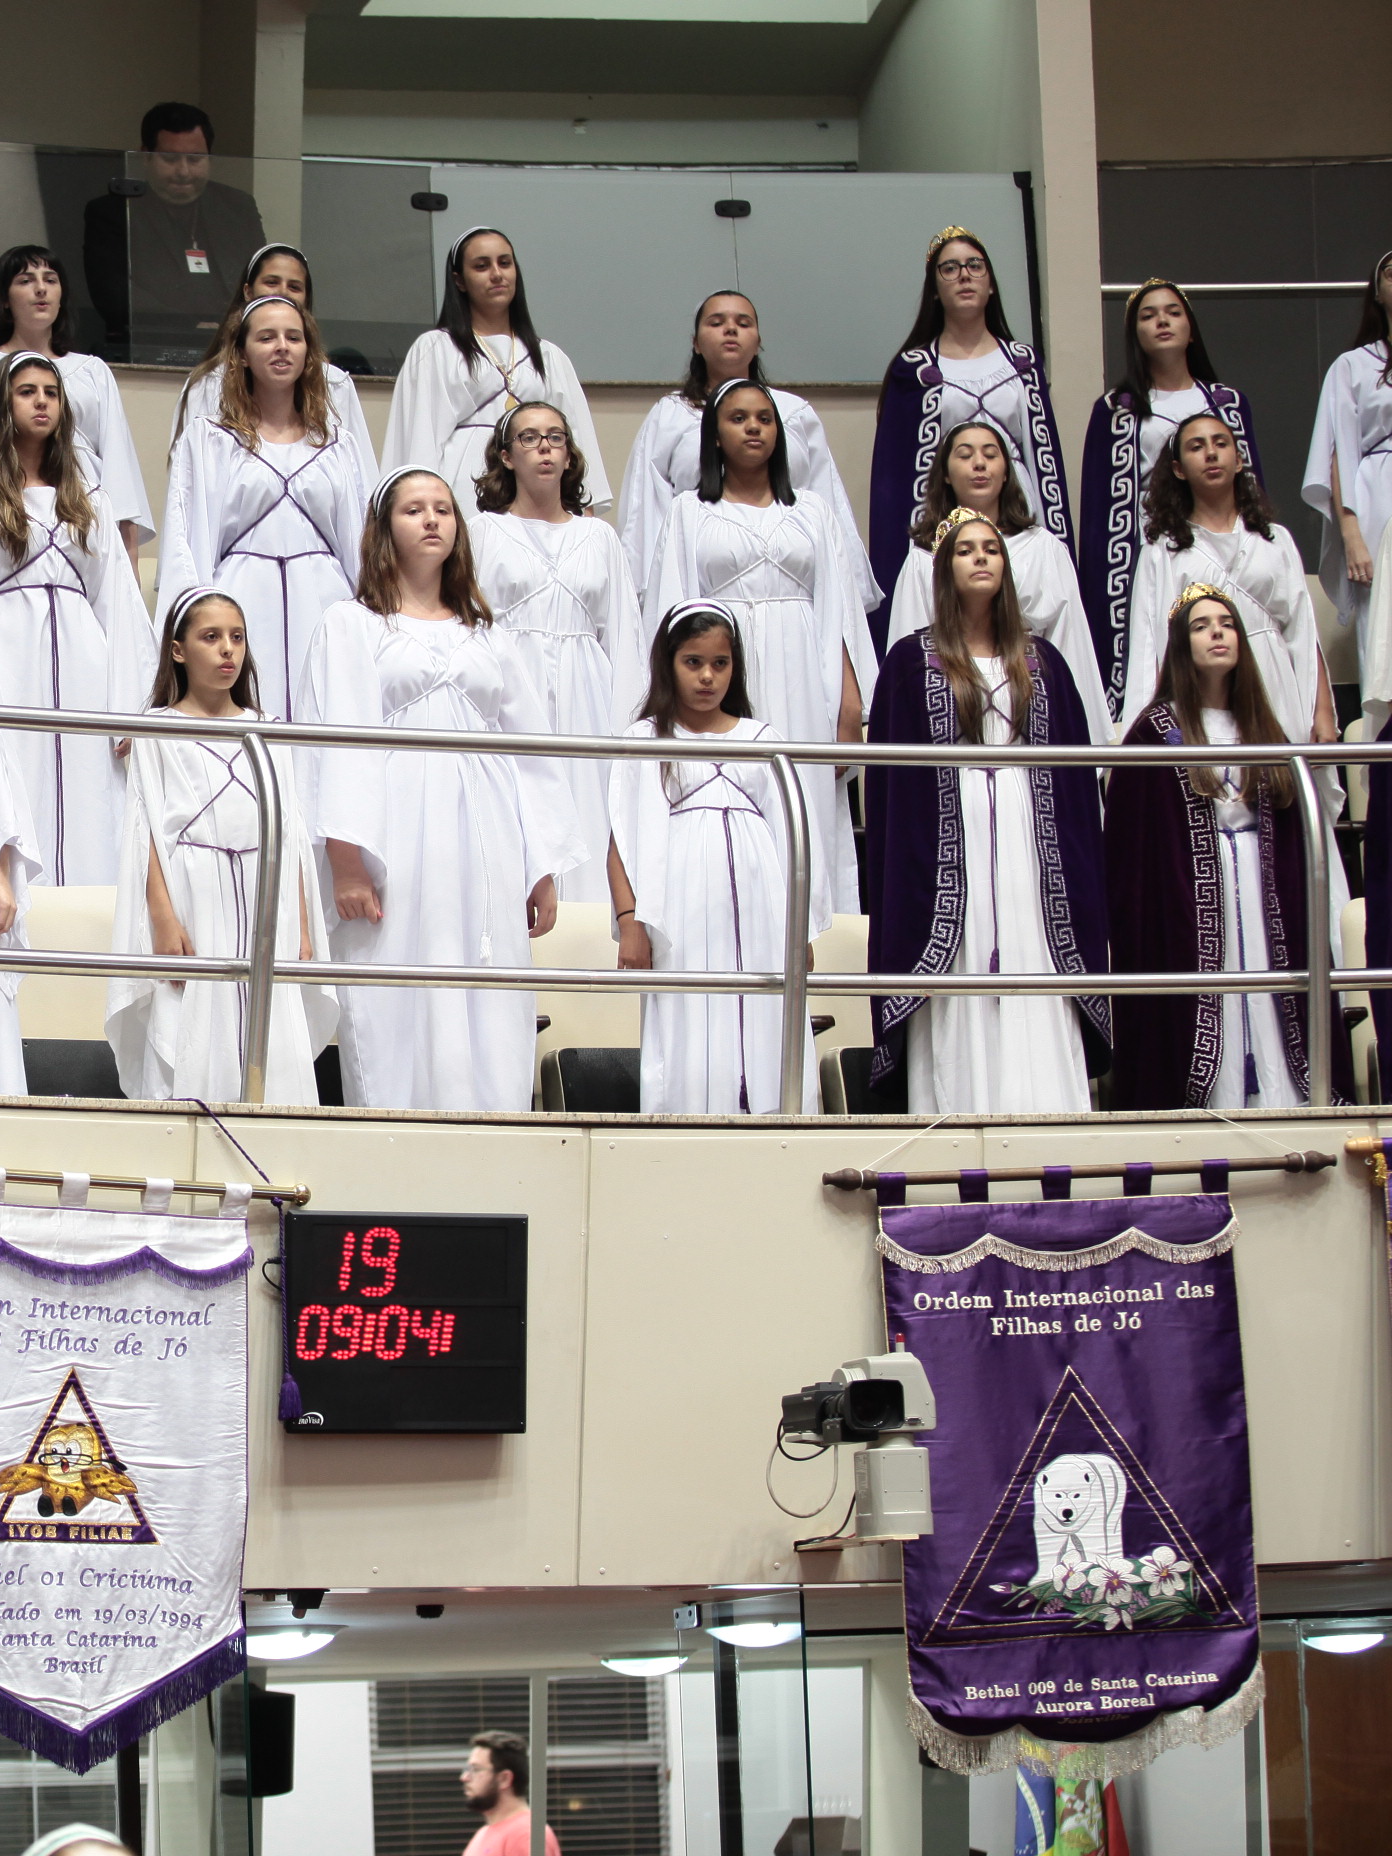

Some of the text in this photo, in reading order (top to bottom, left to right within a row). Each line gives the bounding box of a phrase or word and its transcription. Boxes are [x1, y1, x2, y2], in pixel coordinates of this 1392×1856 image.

[338, 1226, 401, 1298] 19
[913, 1280, 1215, 1311] Ordem Internacional das
[27, 1297, 216, 1327] Internacional
[991, 1311, 1143, 1336] Filhas de Jó
[17, 1328, 99, 1354] Filhas
[113, 1332, 143, 1357] de
[157, 1336, 188, 1361] Jó
[8, 1523, 133, 1541] IYOB FILIAE
[40, 1570, 65, 1587] 01
[79, 1566, 195, 1595] Criciúma
[54, 1608, 83, 1622] em
[93, 1602, 204, 1631] 19/03/1994
[66, 1630, 159, 1649] Catarina
[43, 1654, 107, 1675] Brasil
[965, 1670, 1219, 1701] Bethel 009 de Santa Catarina
[1035, 1693, 1155, 1715] Aurora Boreal
